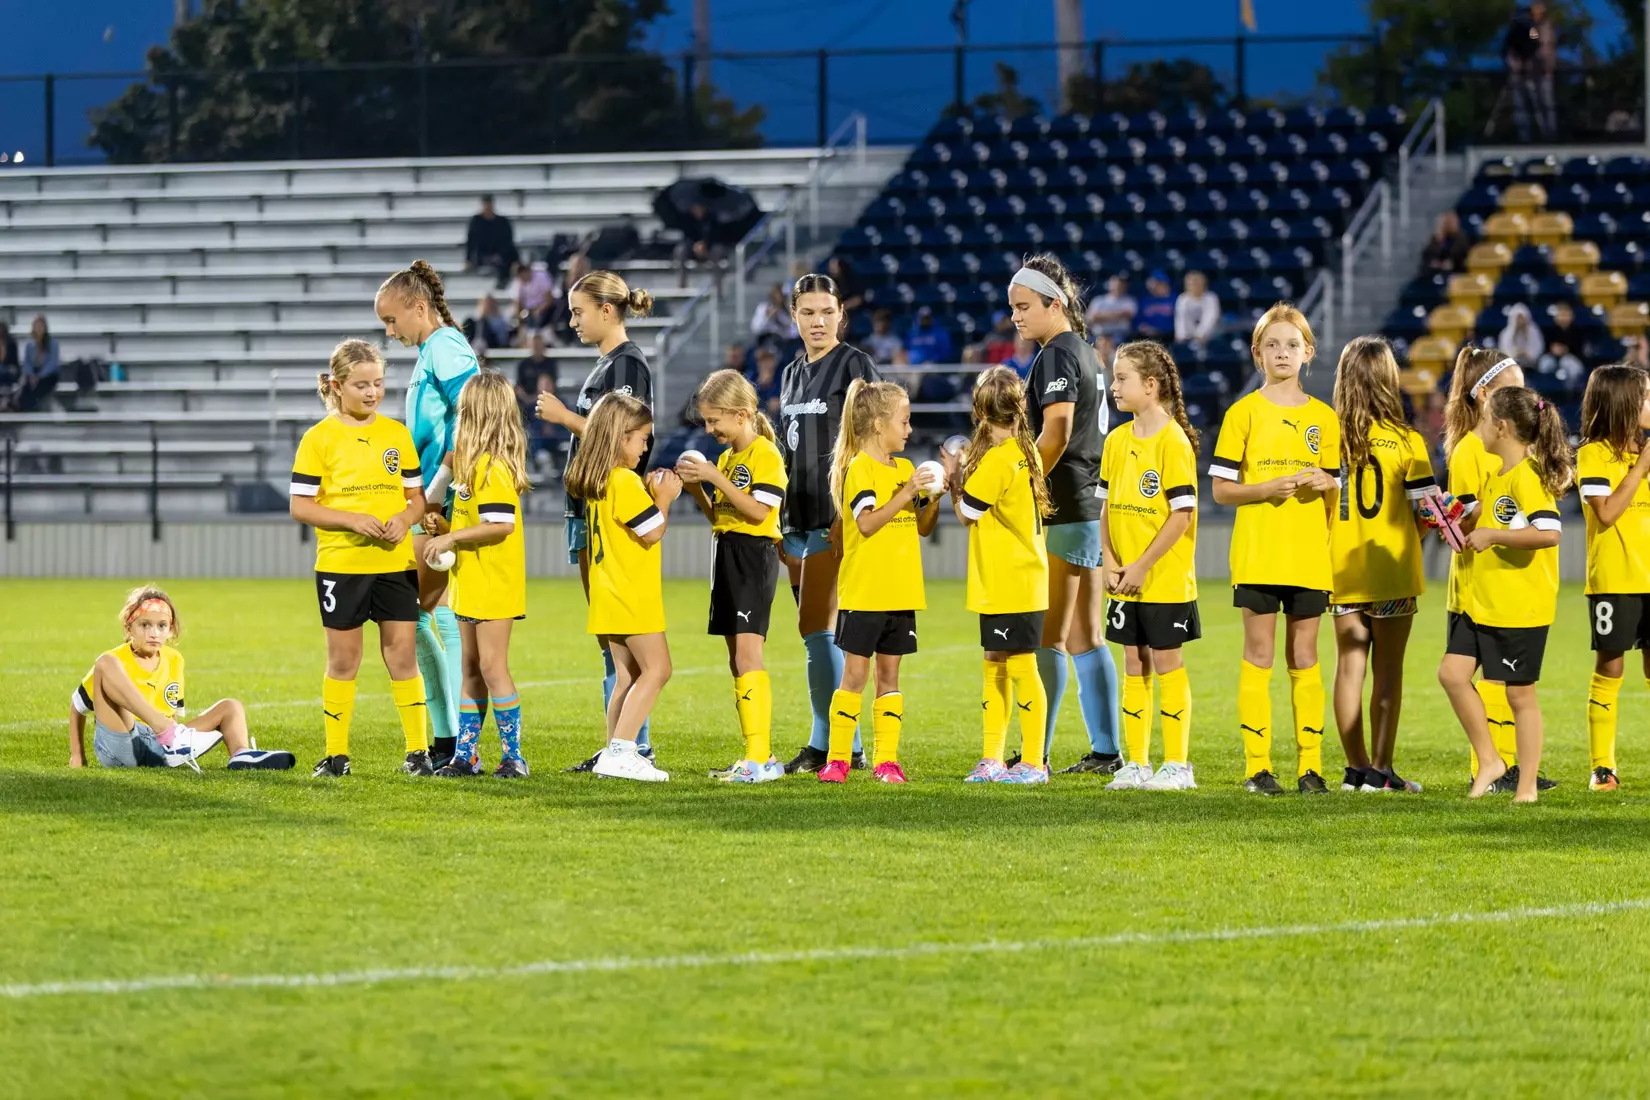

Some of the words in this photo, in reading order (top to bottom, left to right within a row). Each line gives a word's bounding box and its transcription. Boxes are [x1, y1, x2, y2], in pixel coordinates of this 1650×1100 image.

[1485, 362, 1506, 381] SOCCER
[781, 398, 828, 420] arquette
[787, 420, 800, 451] 6
[341, 484, 371, 492] midwest
[1340, 453, 1384, 521] 10
[1122, 504, 1157, 515] orthopedic
[322, 579, 336, 613] 3
[1595, 601, 1614, 636] 8
